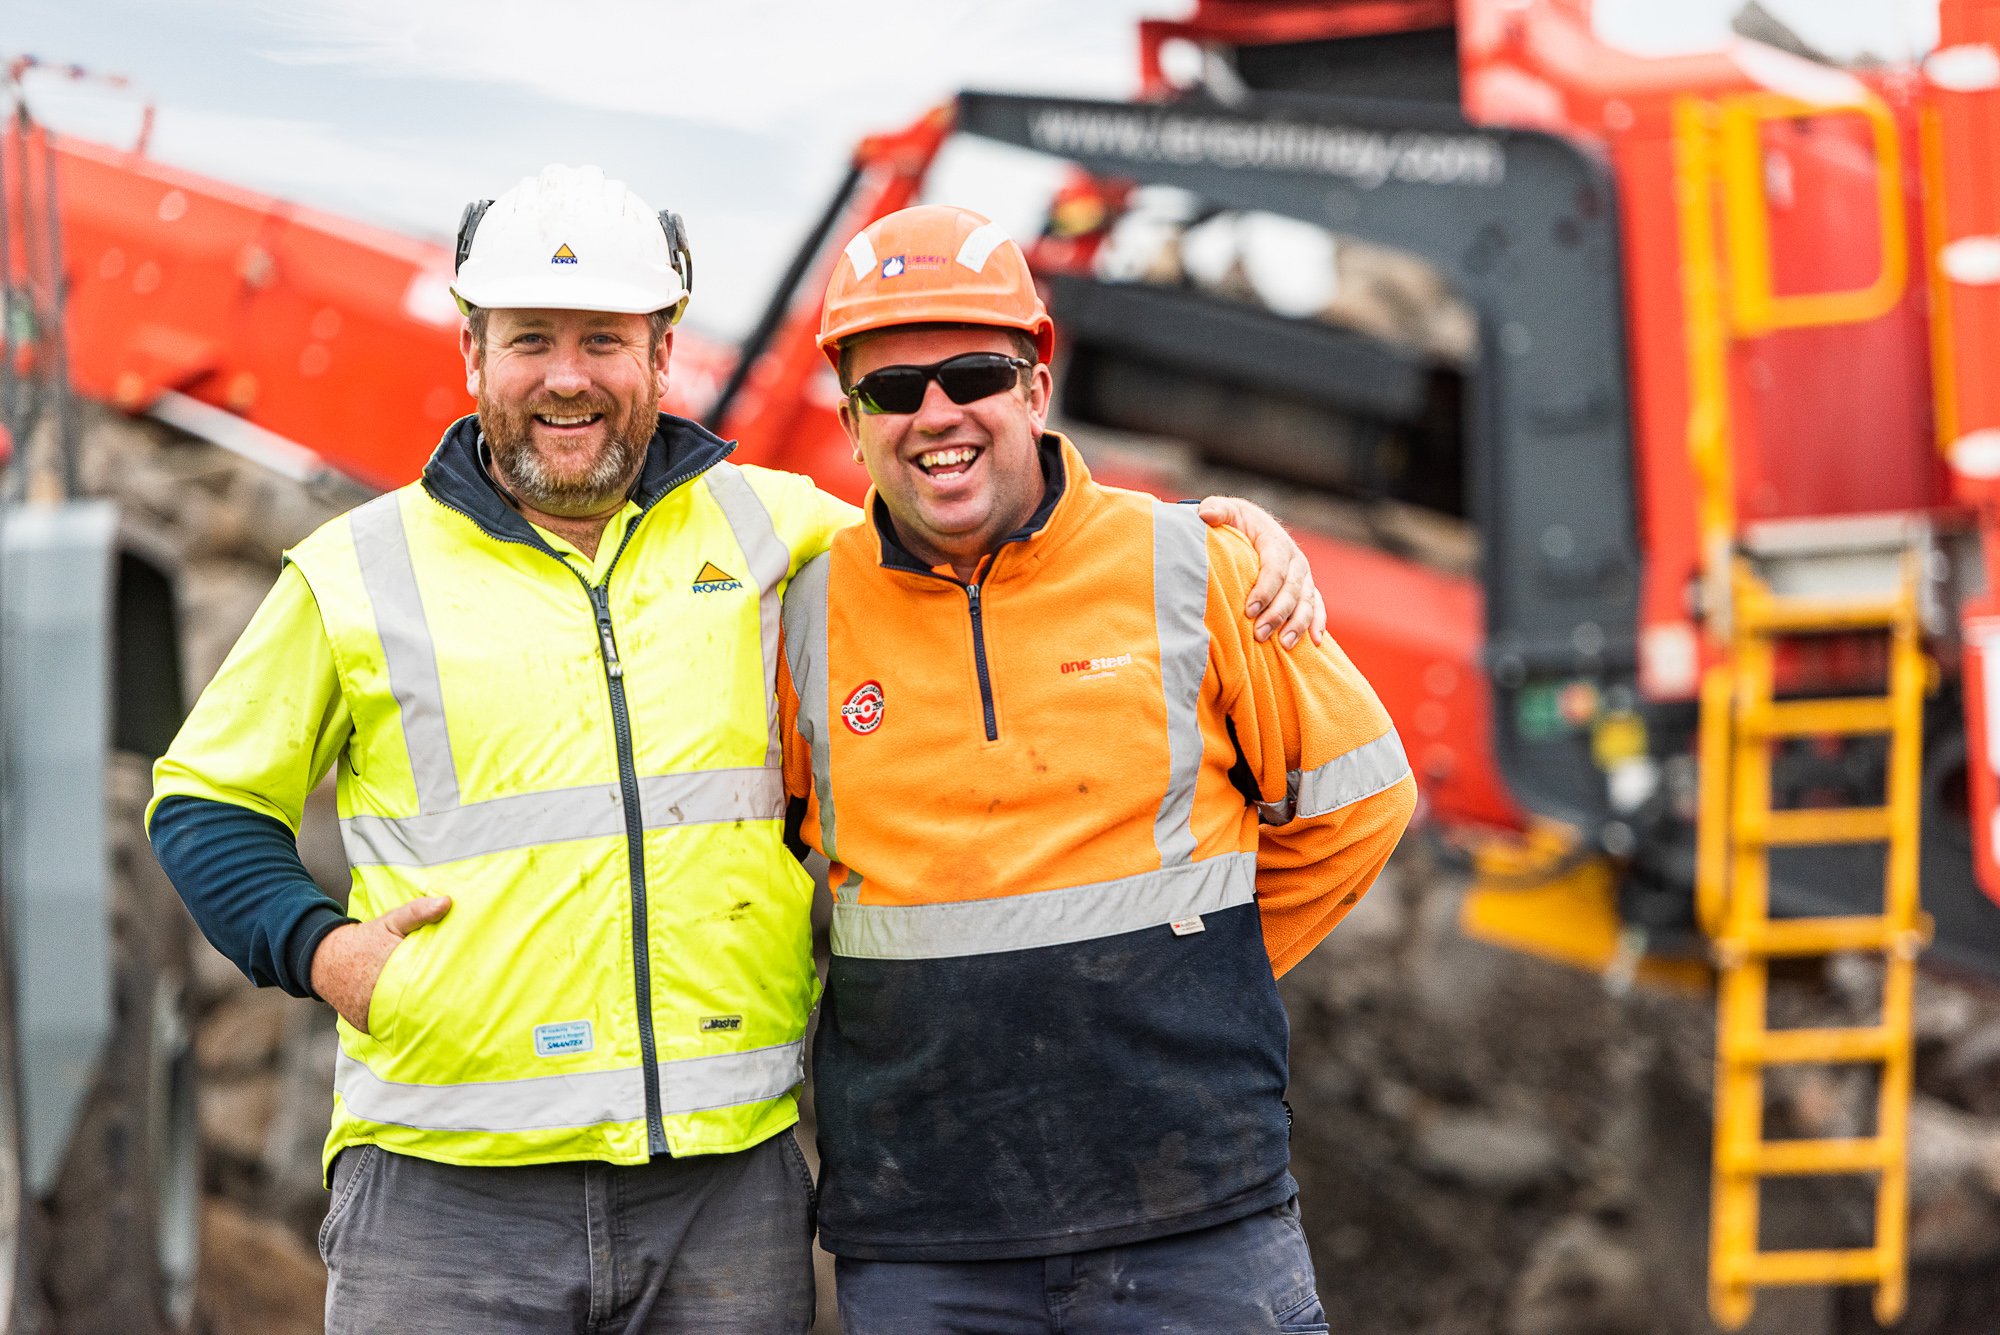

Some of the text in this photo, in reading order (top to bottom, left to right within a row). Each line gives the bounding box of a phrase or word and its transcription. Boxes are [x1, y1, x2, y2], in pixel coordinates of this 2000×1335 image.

[692, 581, 743, 594] ROKON
[1060, 652, 1133, 675] onesteel
[842, 706, 863, 715] GOAL
